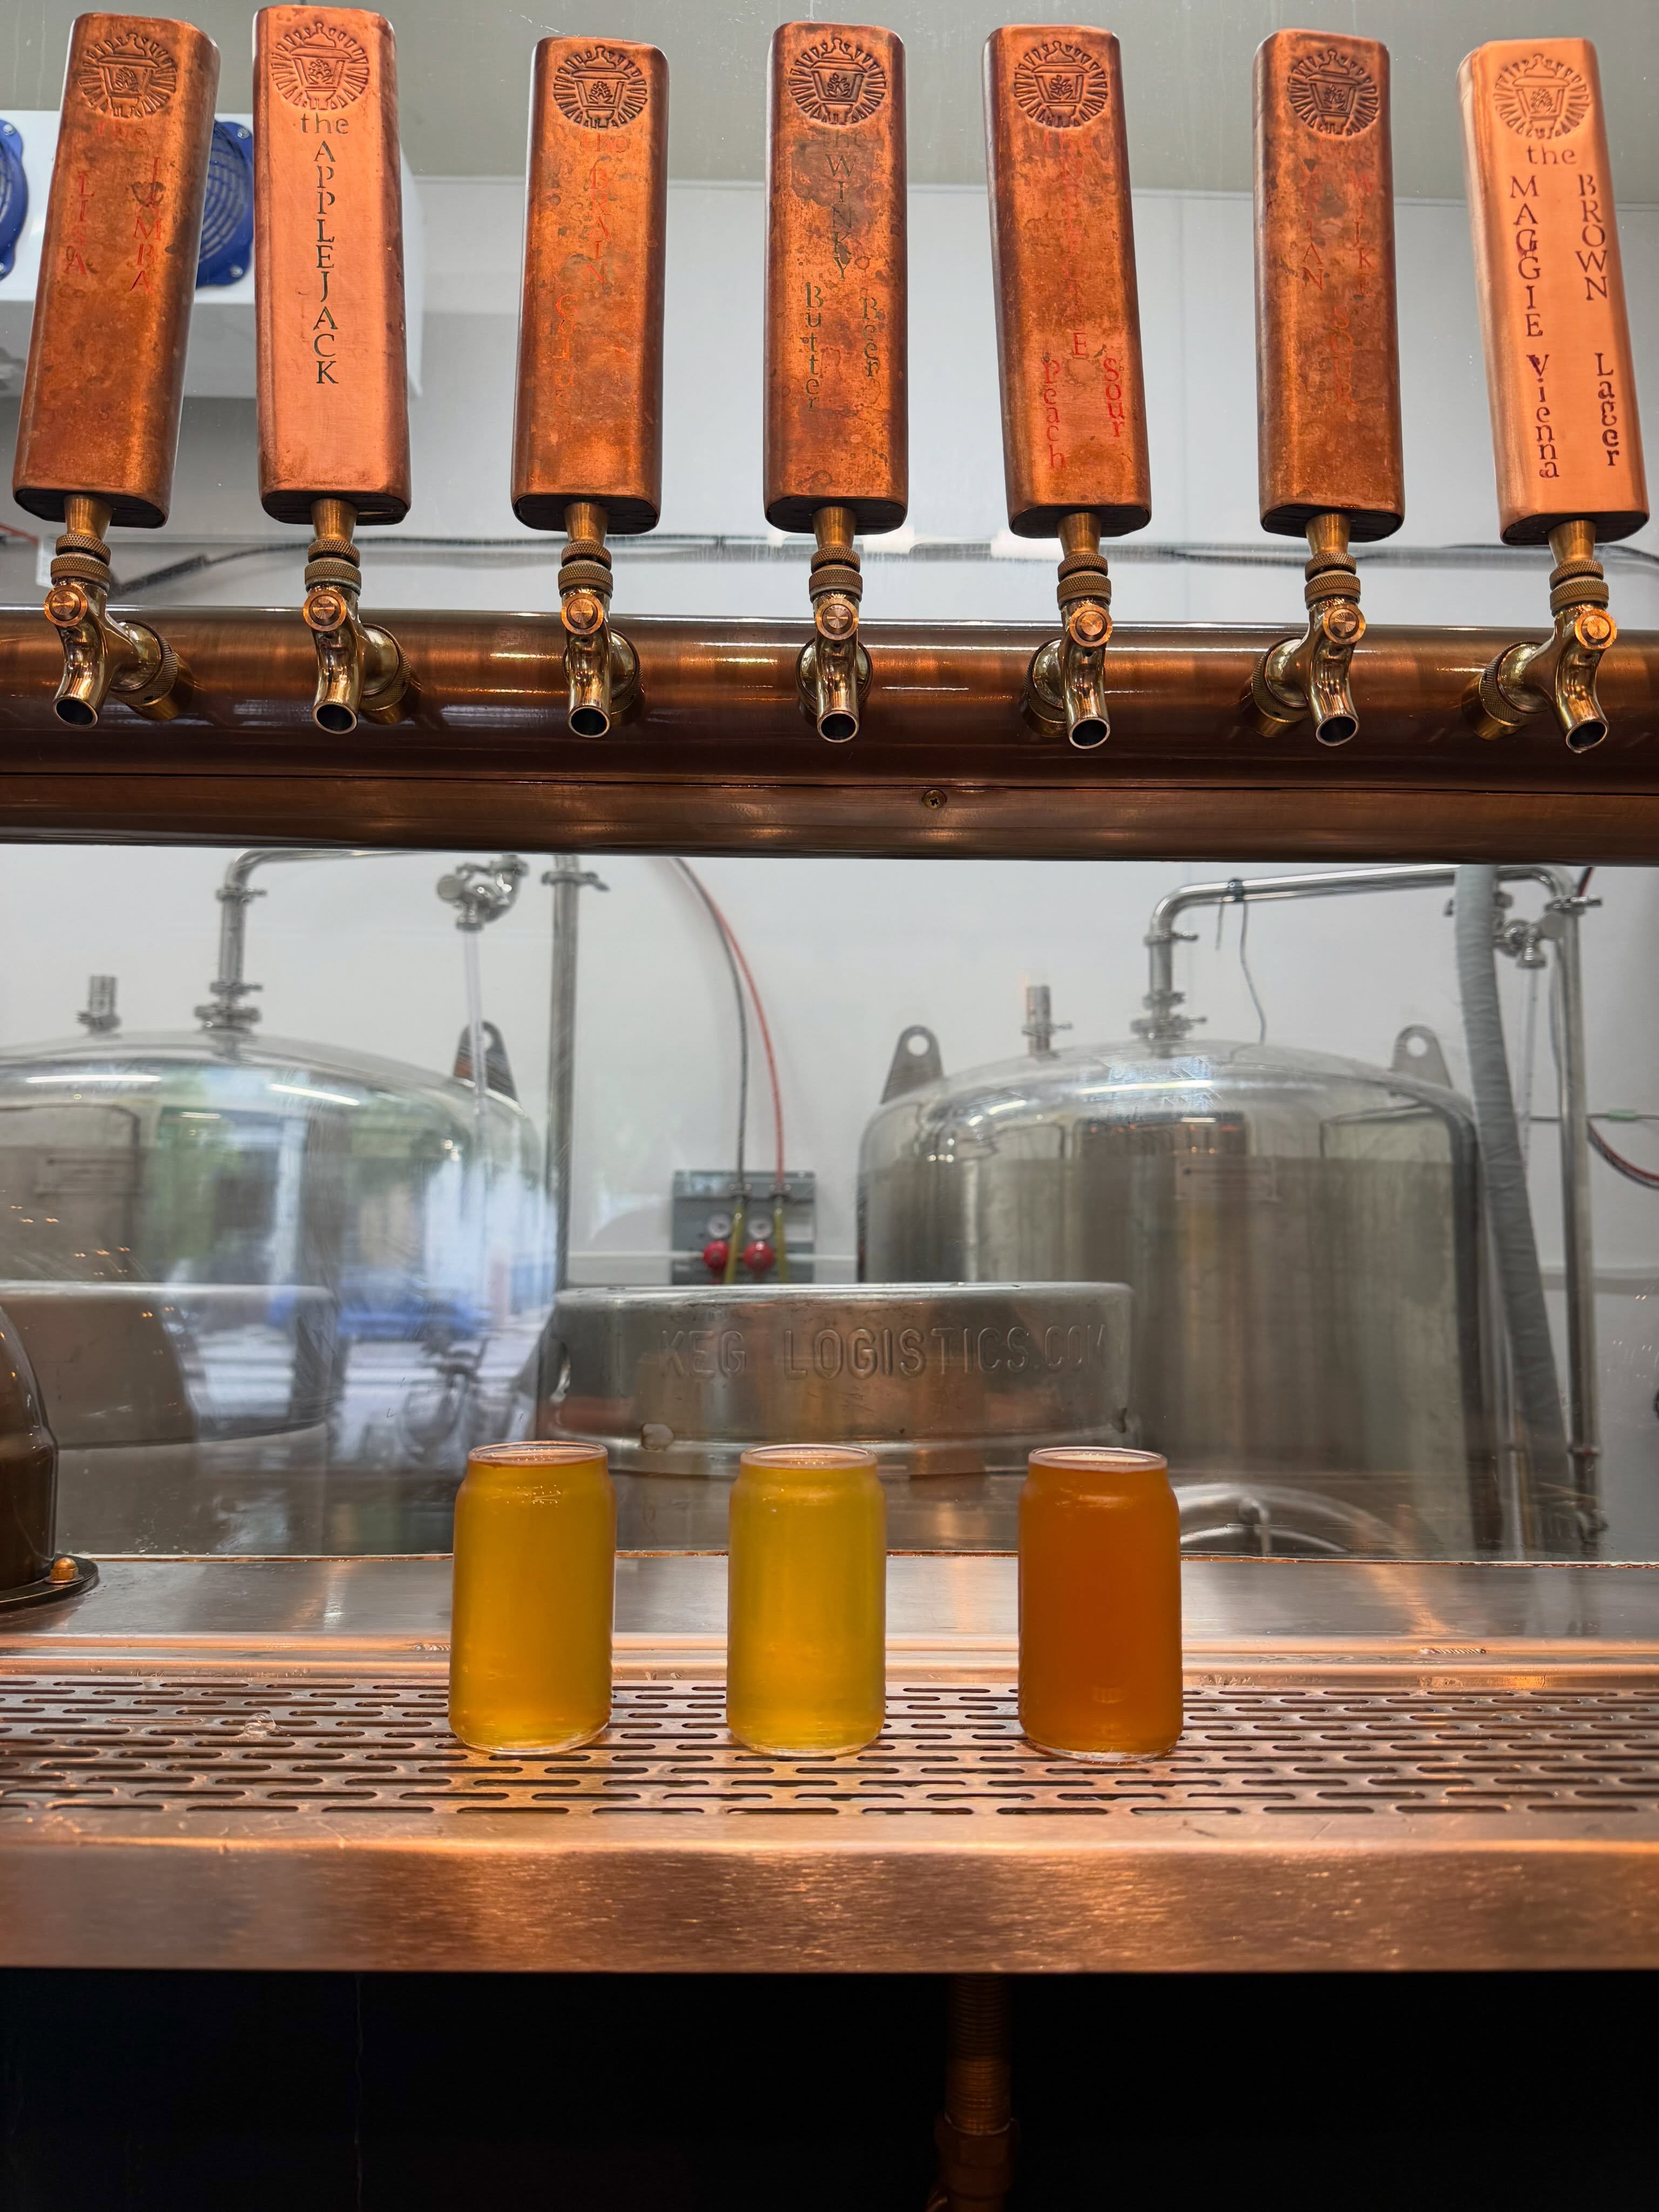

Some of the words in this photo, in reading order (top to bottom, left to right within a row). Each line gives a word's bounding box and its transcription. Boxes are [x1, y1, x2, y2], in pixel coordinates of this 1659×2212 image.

[301, 114, 350, 136] the
[1527, 145, 1576, 166] the
[64, 171, 96, 275] LISA
[313, 141, 339, 385] APPLEJACK
[825, 154, 854, 281] WINKY
[1509, 174, 1543, 338] MAGGIE
[1576, 173, 1609, 301] BROWN
[804, 282, 825, 413] Butter
[861, 296, 881, 379] Beer
[1042, 357, 1066, 469] Peach
[1102, 357, 1125, 439] Sour
[1525, 354, 1560, 479] Vienna
[660, 1330, 747, 1377] KEG
